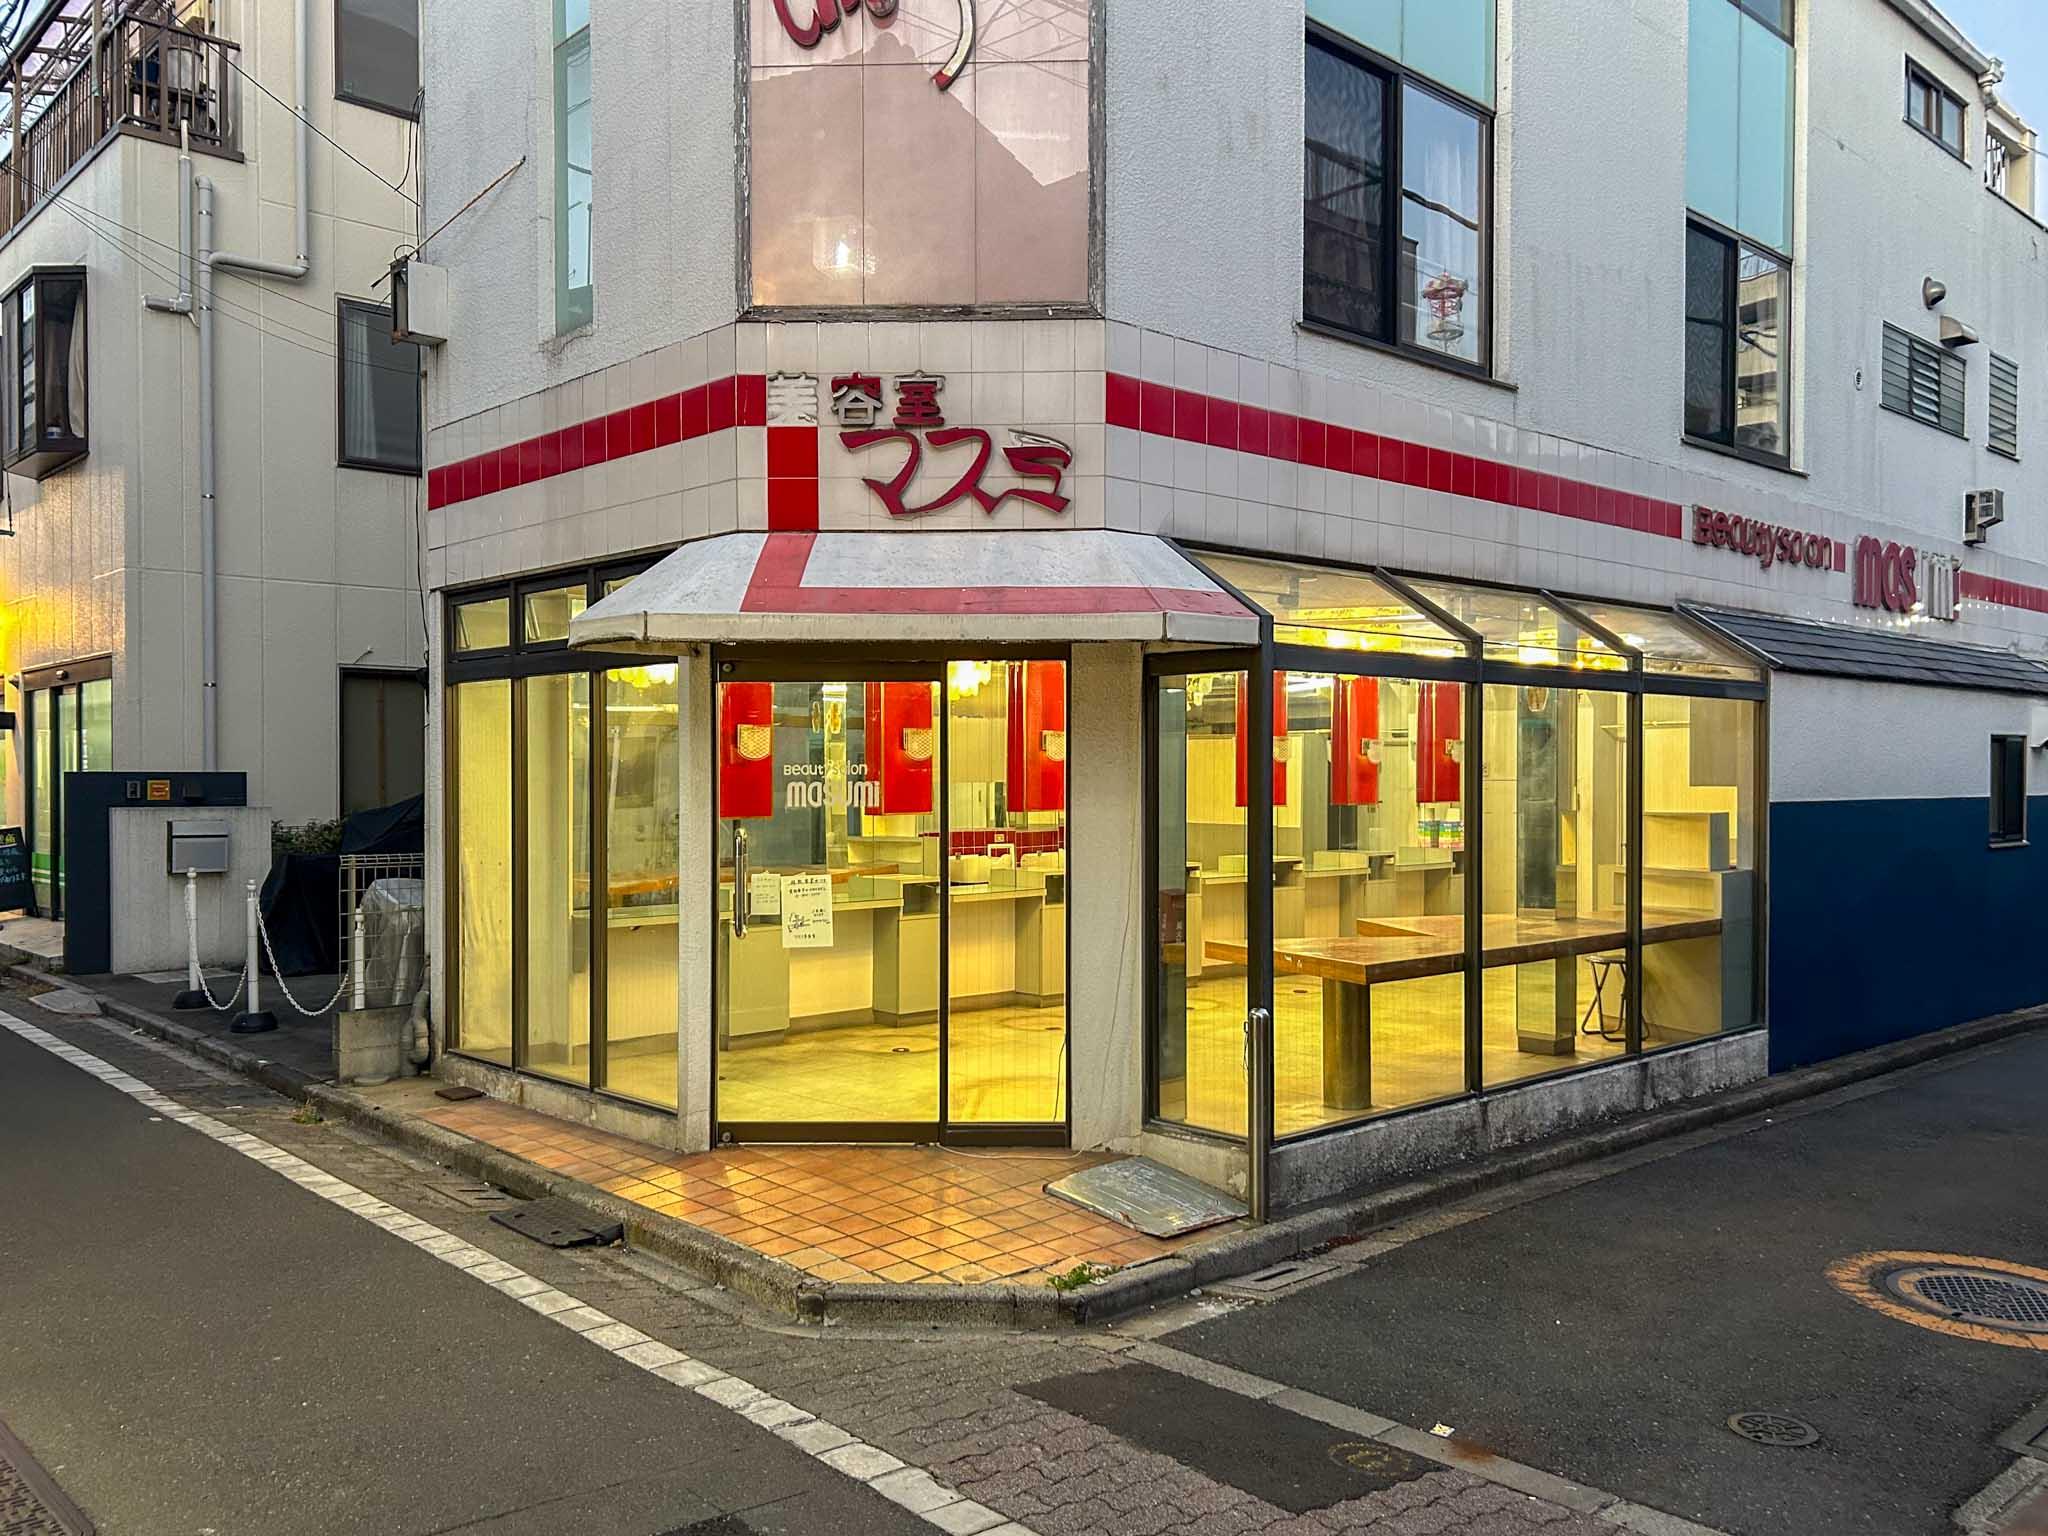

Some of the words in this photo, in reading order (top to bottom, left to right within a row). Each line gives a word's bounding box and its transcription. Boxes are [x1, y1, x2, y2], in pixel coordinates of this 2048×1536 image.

[767, 369, 946, 427] 美容室
[838, 426, 1073, 517] マスミ
